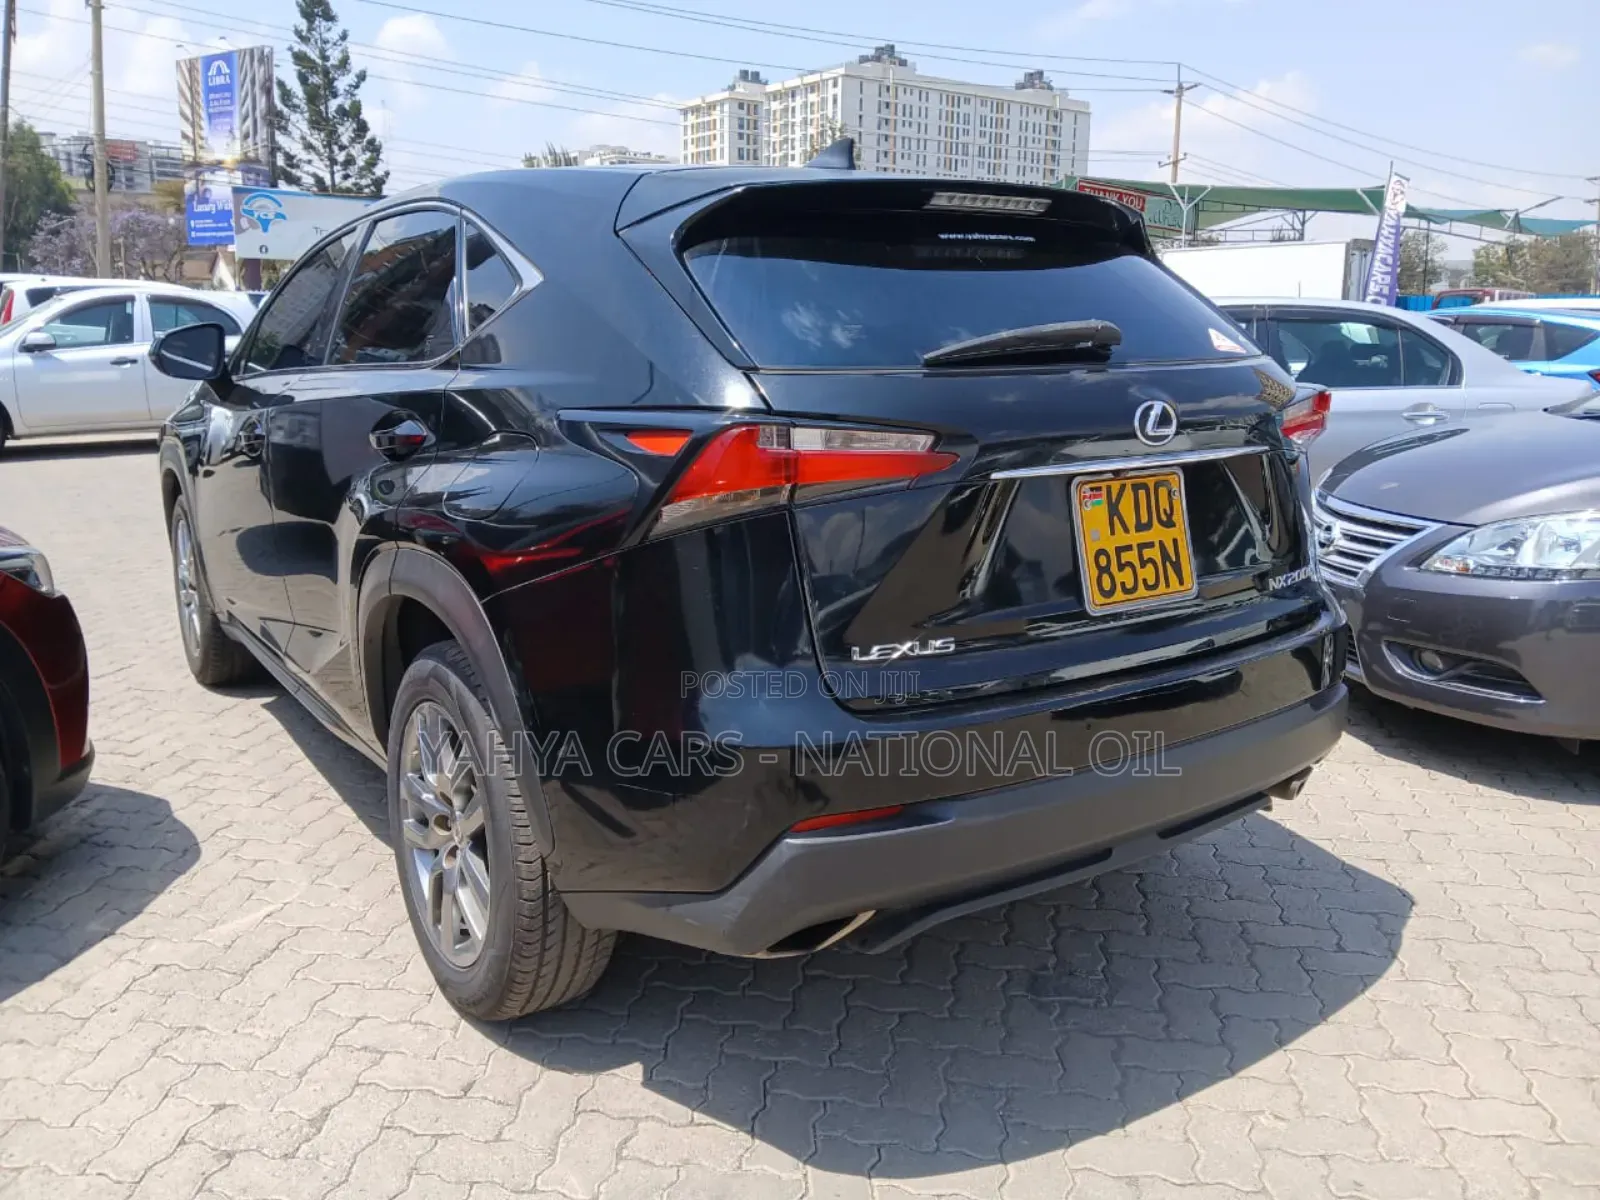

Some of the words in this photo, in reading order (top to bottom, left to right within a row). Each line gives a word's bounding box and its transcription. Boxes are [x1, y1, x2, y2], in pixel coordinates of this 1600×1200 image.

[208, 74, 231, 86] LIBRA
[193, 196, 216, 214] Luxury
[1122, 193, 1143, 209] YOU
[1105, 479, 1177, 537] KDQ
[1093, 538, 1185, 599] 855N
[851, 637, 955, 661] LEXUS
